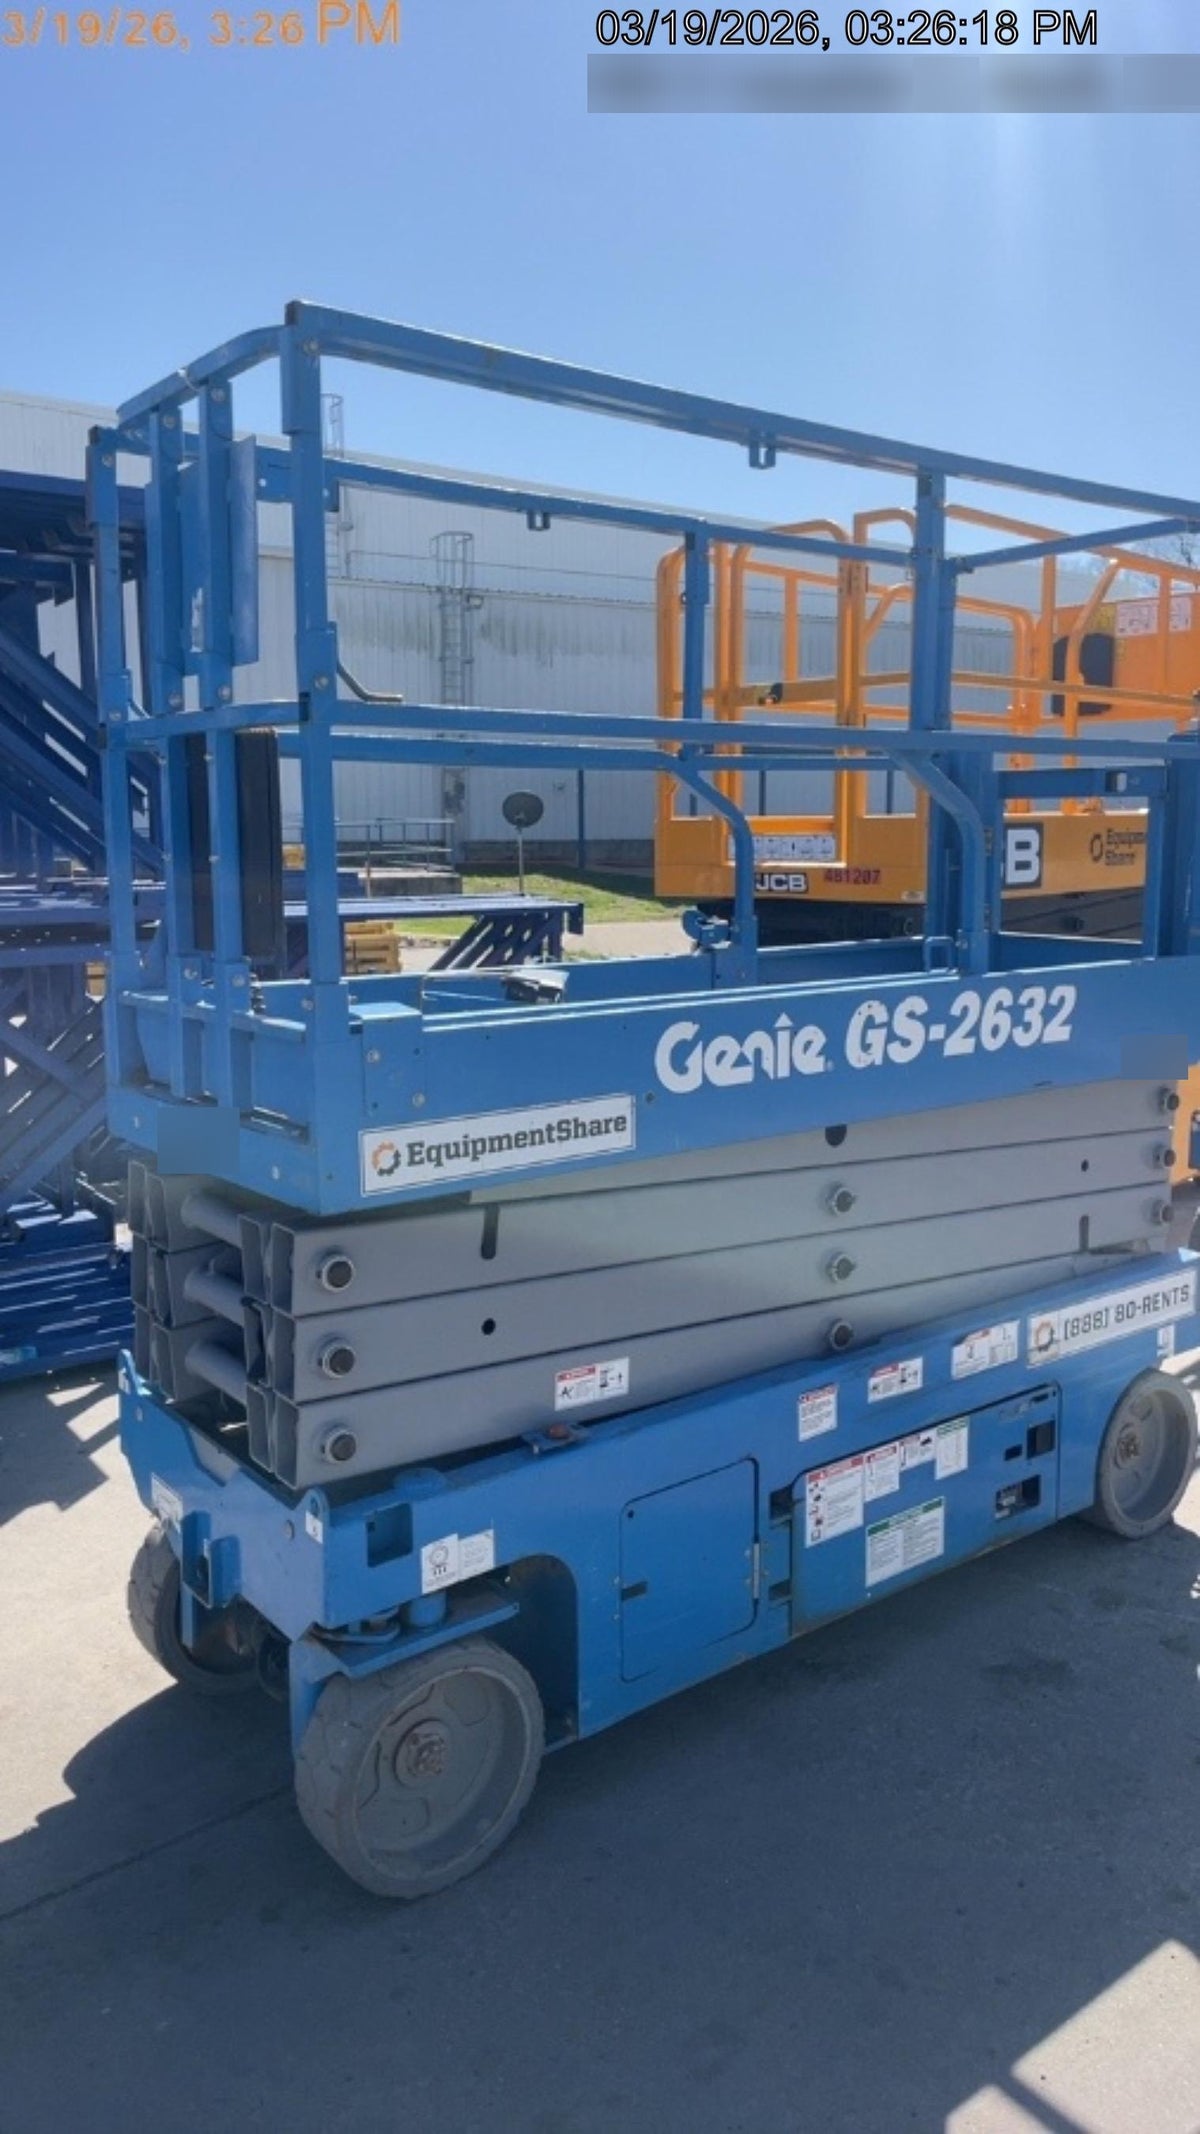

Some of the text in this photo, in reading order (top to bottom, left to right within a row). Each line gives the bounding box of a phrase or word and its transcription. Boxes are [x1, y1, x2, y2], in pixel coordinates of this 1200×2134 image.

[755, 874, 807, 892] JCB
[1001, 828, 1040, 885] B
[654, 984, 1078, 1094] Genie GS-2632
[406, 1114, 627, 1168] EquipmentShare
[1114, 1284, 1190, 1323] 80-RENTS
